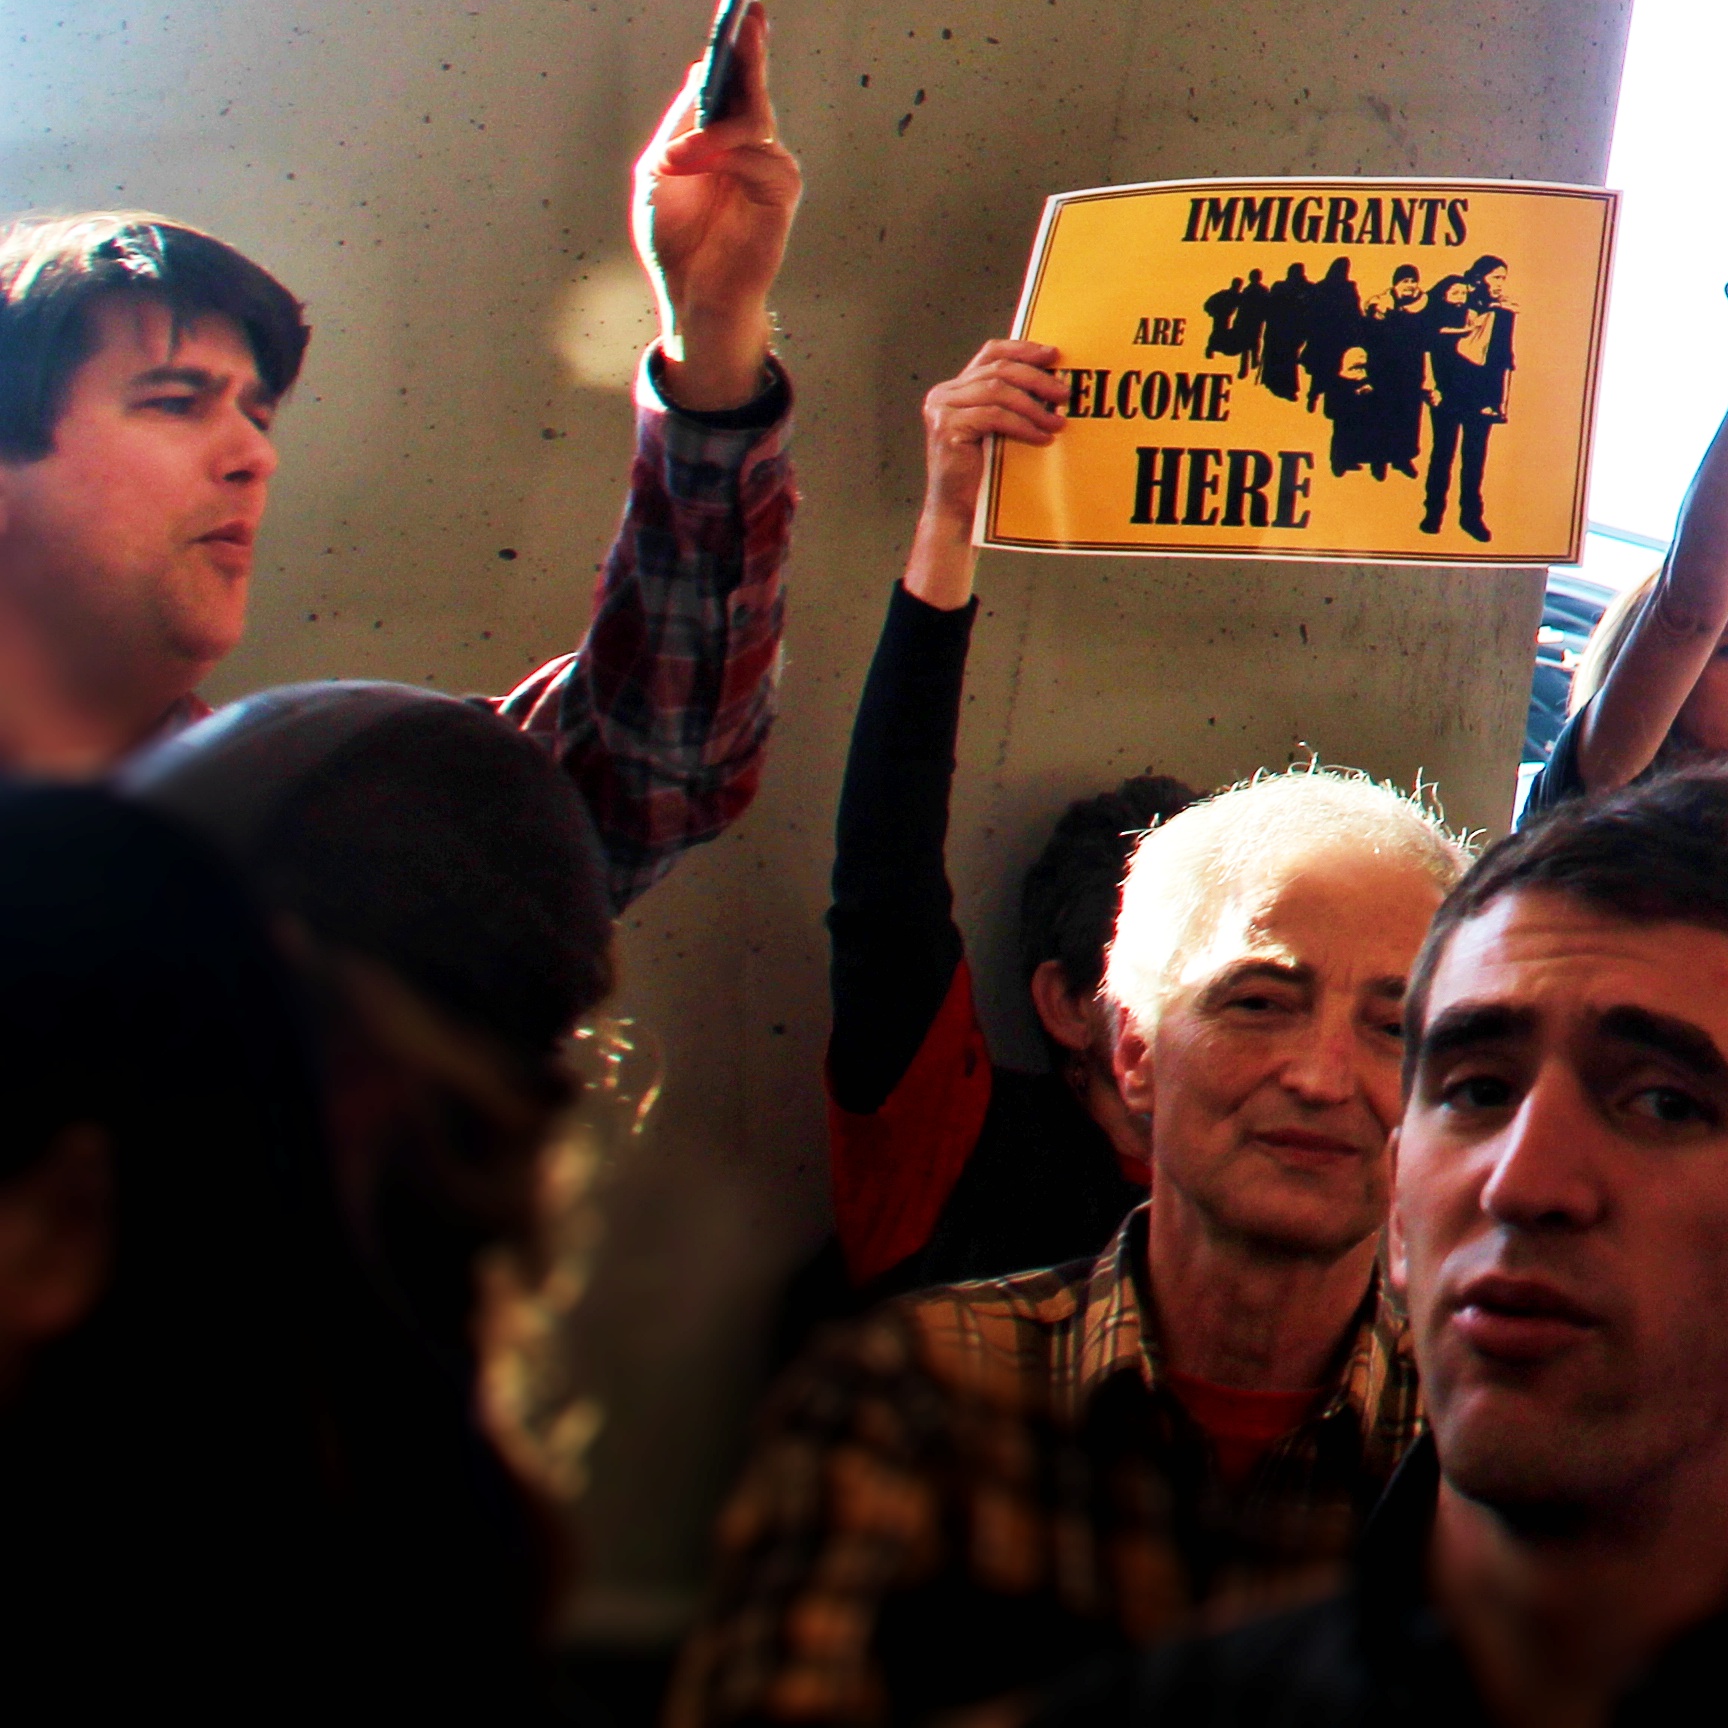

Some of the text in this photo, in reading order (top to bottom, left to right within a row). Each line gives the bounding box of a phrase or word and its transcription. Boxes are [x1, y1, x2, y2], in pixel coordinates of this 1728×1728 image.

[1180, 196, 1470, 249] IMMIGRANTS
[1132, 316, 1187, 348] ARE
[1040, 367, 1233, 422] ELCOME
[1129, 445, 1316, 530] HERE
